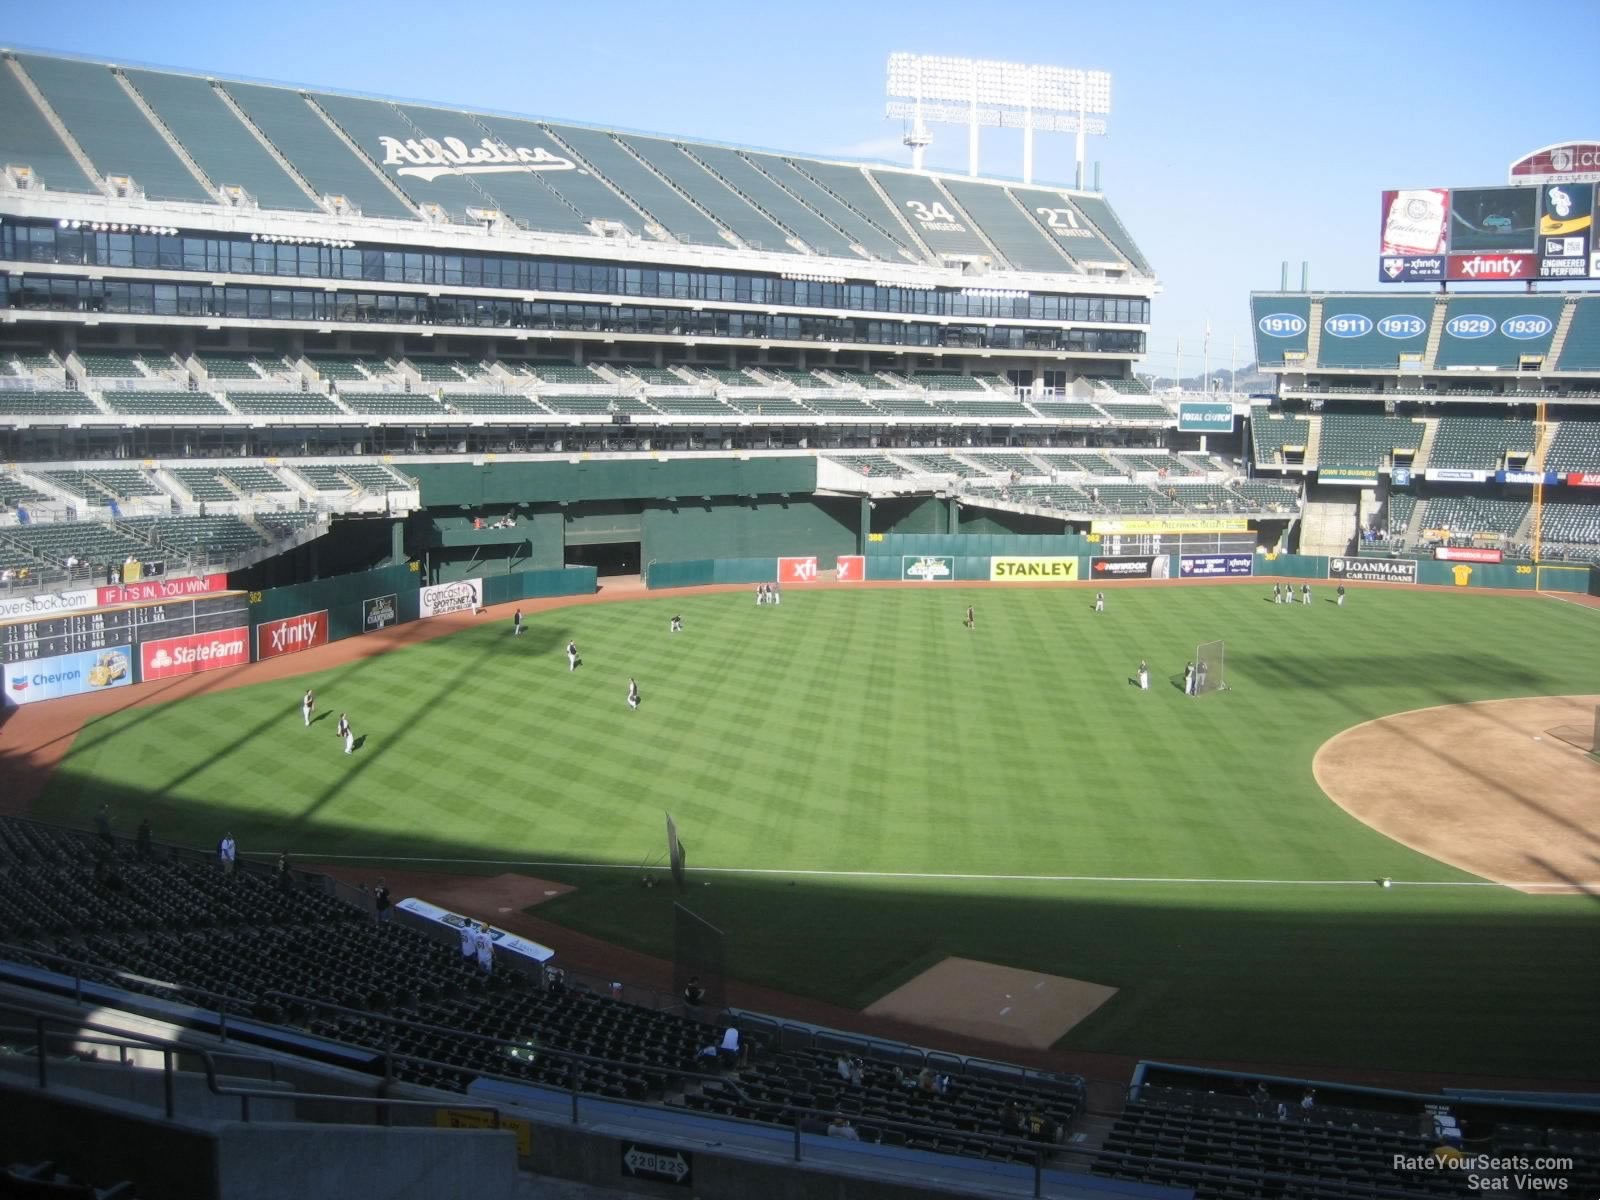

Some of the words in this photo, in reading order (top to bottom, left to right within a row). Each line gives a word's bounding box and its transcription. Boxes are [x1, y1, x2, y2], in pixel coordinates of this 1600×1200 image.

[378, 135, 572, 173] Athletics
[906, 200, 955, 222] 34
[1036, 207, 1079, 229] 27
[920, 222, 966, 232] FINGERS
[1054, 228, 1094, 238] HUNTER
[1410, 259, 1441, 270] xfinity
[1461, 257, 1519, 276] xfinity
[1542, 259, 1586, 268] ENGINEERED
[1540, 268, 1550, 276] TO
[1264, 319, 1301, 333] 1910
[1329, 319, 1365, 333] 1911
[1382, 319, 1420, 333] 1913
[1450, 319, 1490, 334] 1929
[1507, 320, 1546, 334] 1930
[1182, 413, 1203, 422] TOTAL
[1204, 413, 1231, 422] CLUTCH
[1347, 469, 1377, 477] BUSINESS
[1229, 558, 1251, 568] xfinity
[996, 562, 1073, 576] STANLEY
[1516, 565, 1532, 574] 330
[1346, 572, 1361, 580] CAR
[1363, 573, 1386, 581] TITLE
[1387, 575, 1412, 583] LOANS
[105, 589, 115, 603] IF
[161, 583, 185, 597] YOU
[187, 579, 210, 593] WIN!
[424, 586, 461, 605] Comcast
[249, 592, 262, 604] 362
[433, 596, 470, 609] SPORTSNET
[153, 613, 165, 621] SEA
[91, 621, 104, 630] TOR
[24, 631, 38, 641] BAL
[91, 631, 104, 640] TEX
[272, 619, 318, 652] xfinity
[24, 641, 39, 651] NYM
[91, 639, 105, 648] HOU
[32, 668, 80, 686] Chevron
